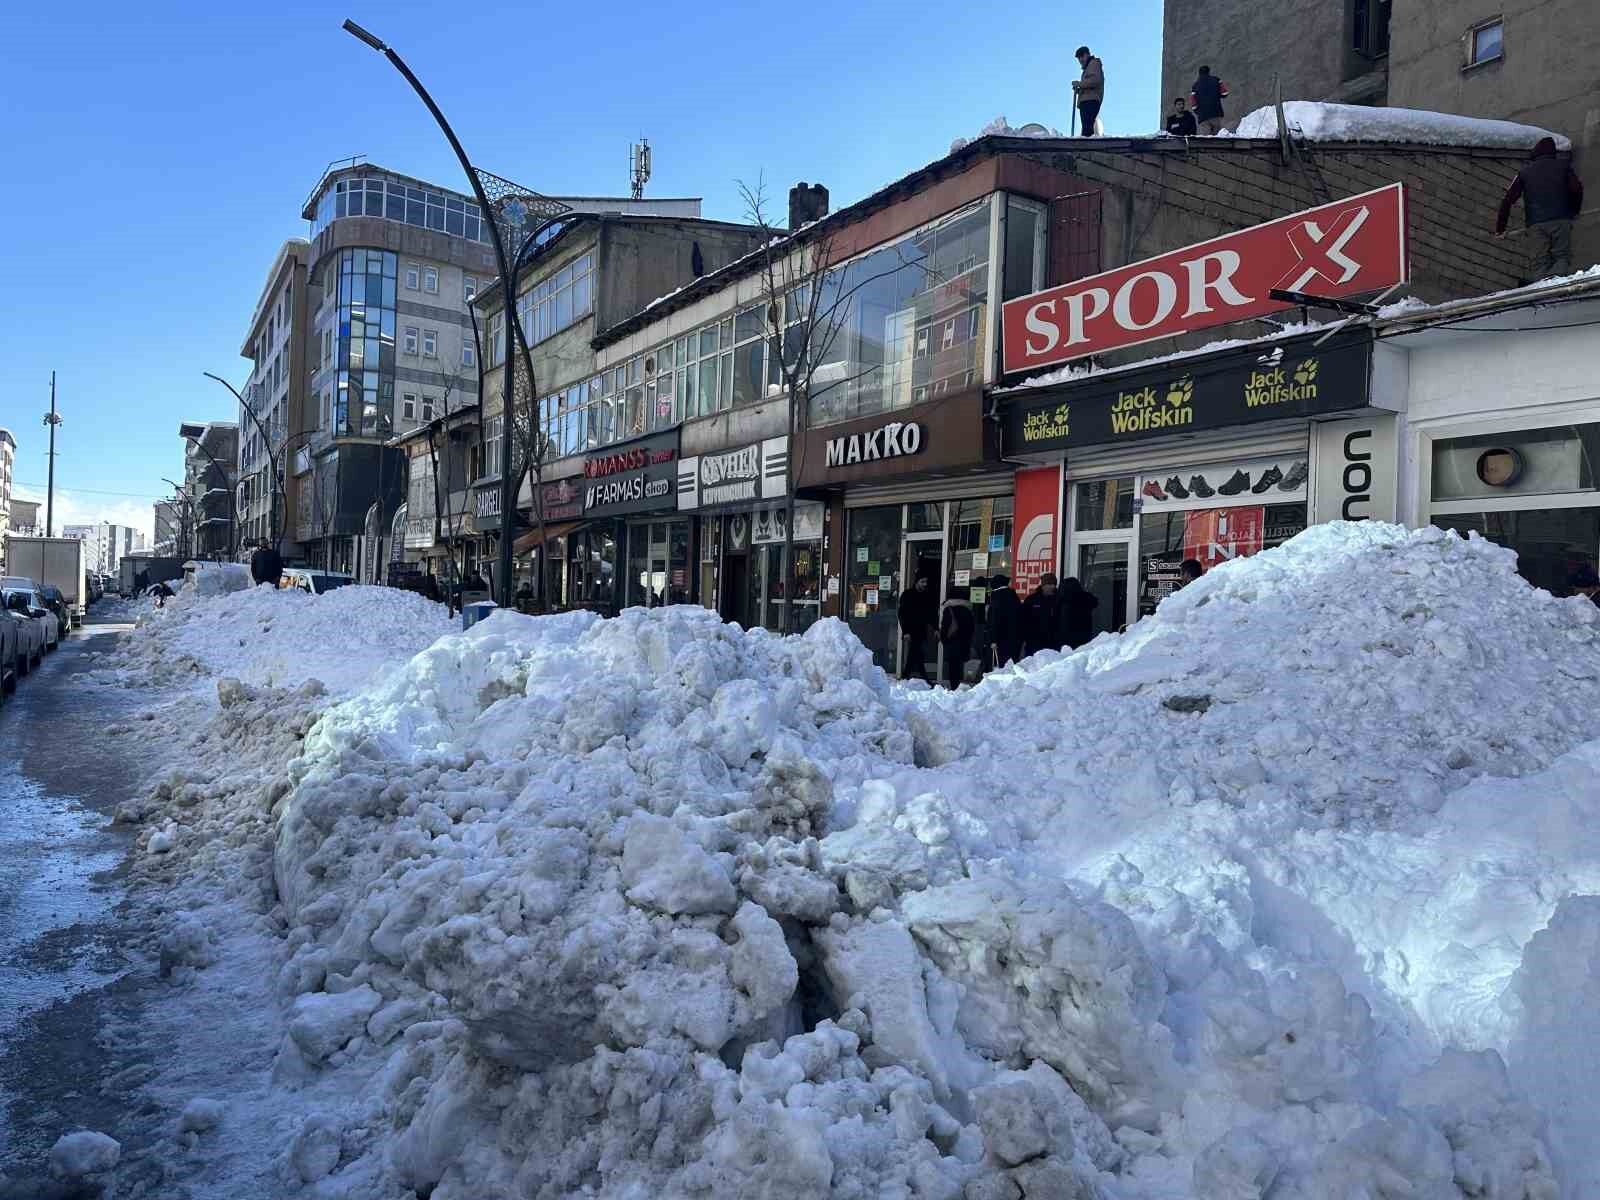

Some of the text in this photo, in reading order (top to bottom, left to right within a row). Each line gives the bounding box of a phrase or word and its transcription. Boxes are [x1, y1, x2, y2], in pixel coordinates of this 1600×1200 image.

[1025, 248, 1256, 357] SPOR
[1245, 366, 1285, 390] Jack
[1112, 387, 1156, 412] Jack
[1245, 382, 1317, 408] Wolfskin
[1024, 410, 1049, 427] Jack
[1112, 404, 1193, 434] Wolfskin
[825, 422, 921, 467] MAKKO
[1024, 424, 1069, 441] Wolfskin
[476, 487, 502, 518] BARGELL
